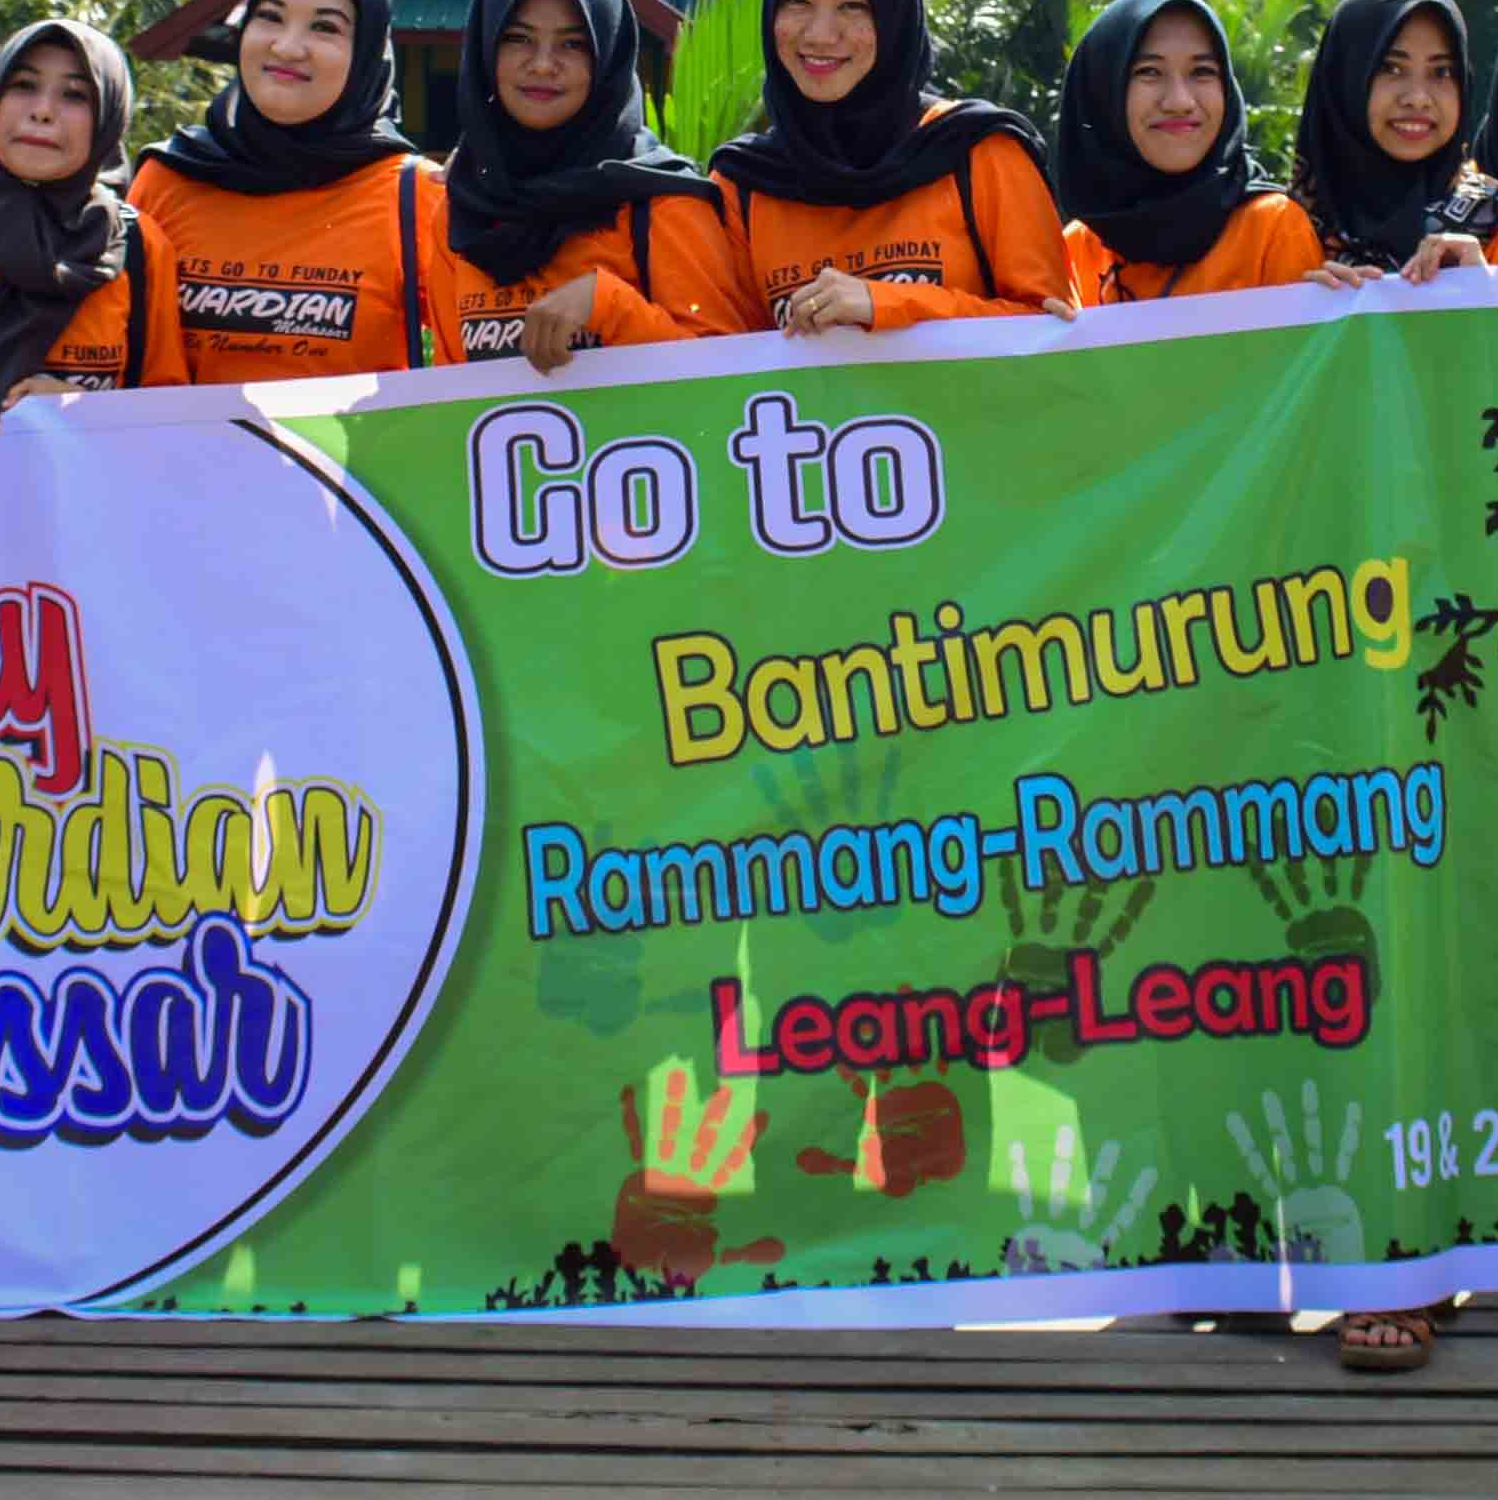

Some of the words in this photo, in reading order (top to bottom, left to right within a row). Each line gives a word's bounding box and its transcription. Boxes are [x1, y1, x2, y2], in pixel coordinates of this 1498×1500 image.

[179, 258, 213, 275] ETS
[220, 259, 245, 278] GO
[257, 263, 280, 280] TO
[291, 265, 364, 285] FUNDAY
[764, 265, 801, 289] LETS
[845, 251, 866, 272] TO
[873, 240, 942, 263] FUNDAY
[468, 399, 699, 579] Go
[726, 390, 945, 560] to
[653, 554, 1412, 767] Bantimurung
[522, 760, 1446, 940] Rammang-Rammang
[710, 948, 1367, 1078] Leang-Leang
